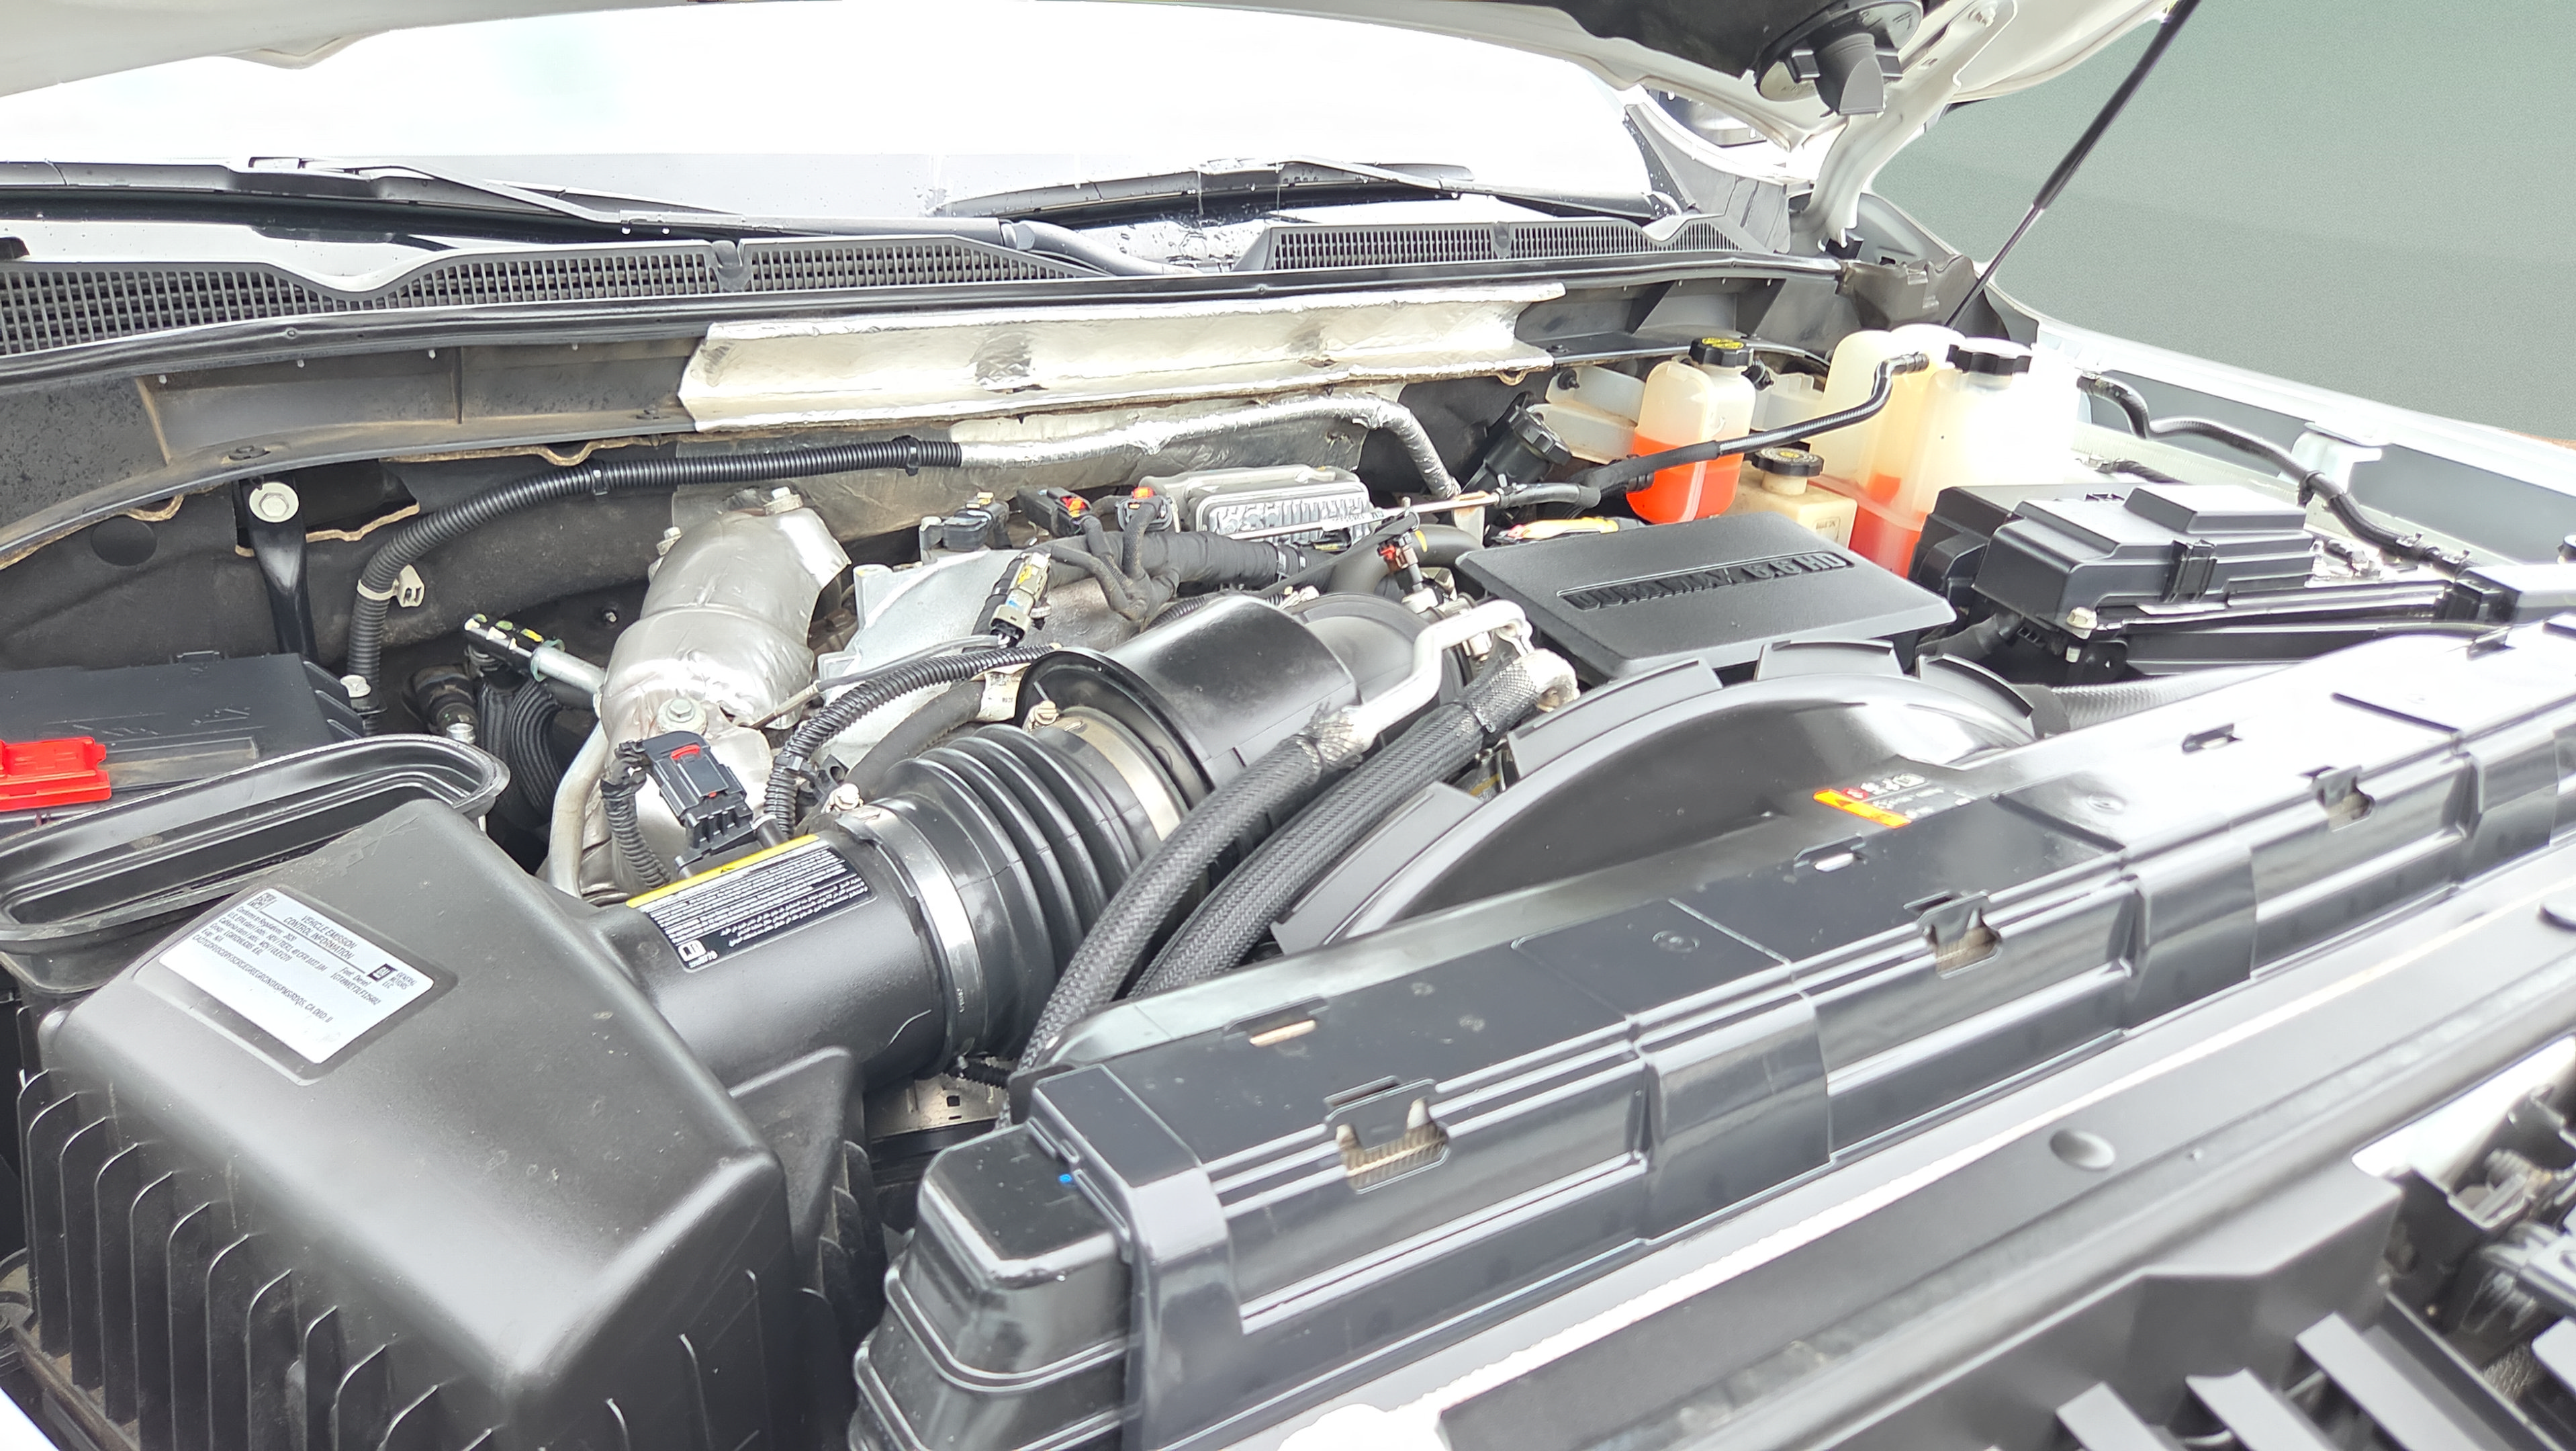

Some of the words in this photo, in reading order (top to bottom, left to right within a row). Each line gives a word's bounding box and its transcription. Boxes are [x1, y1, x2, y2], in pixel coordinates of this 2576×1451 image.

[1565, 570, 1739, 611] DURAMAX
[1741, 559, 1802, 580] 6.6
[1795, 552, 1849, 573] HD
[283, 917, 314, 936] CONTROL
[310, 933, 355, 959] INFORMATION
[302, 916, 330, 933] VEHICLE
[325, 929, 357, 949] EMISSION
[353, 975, 372, 987] Diesel
